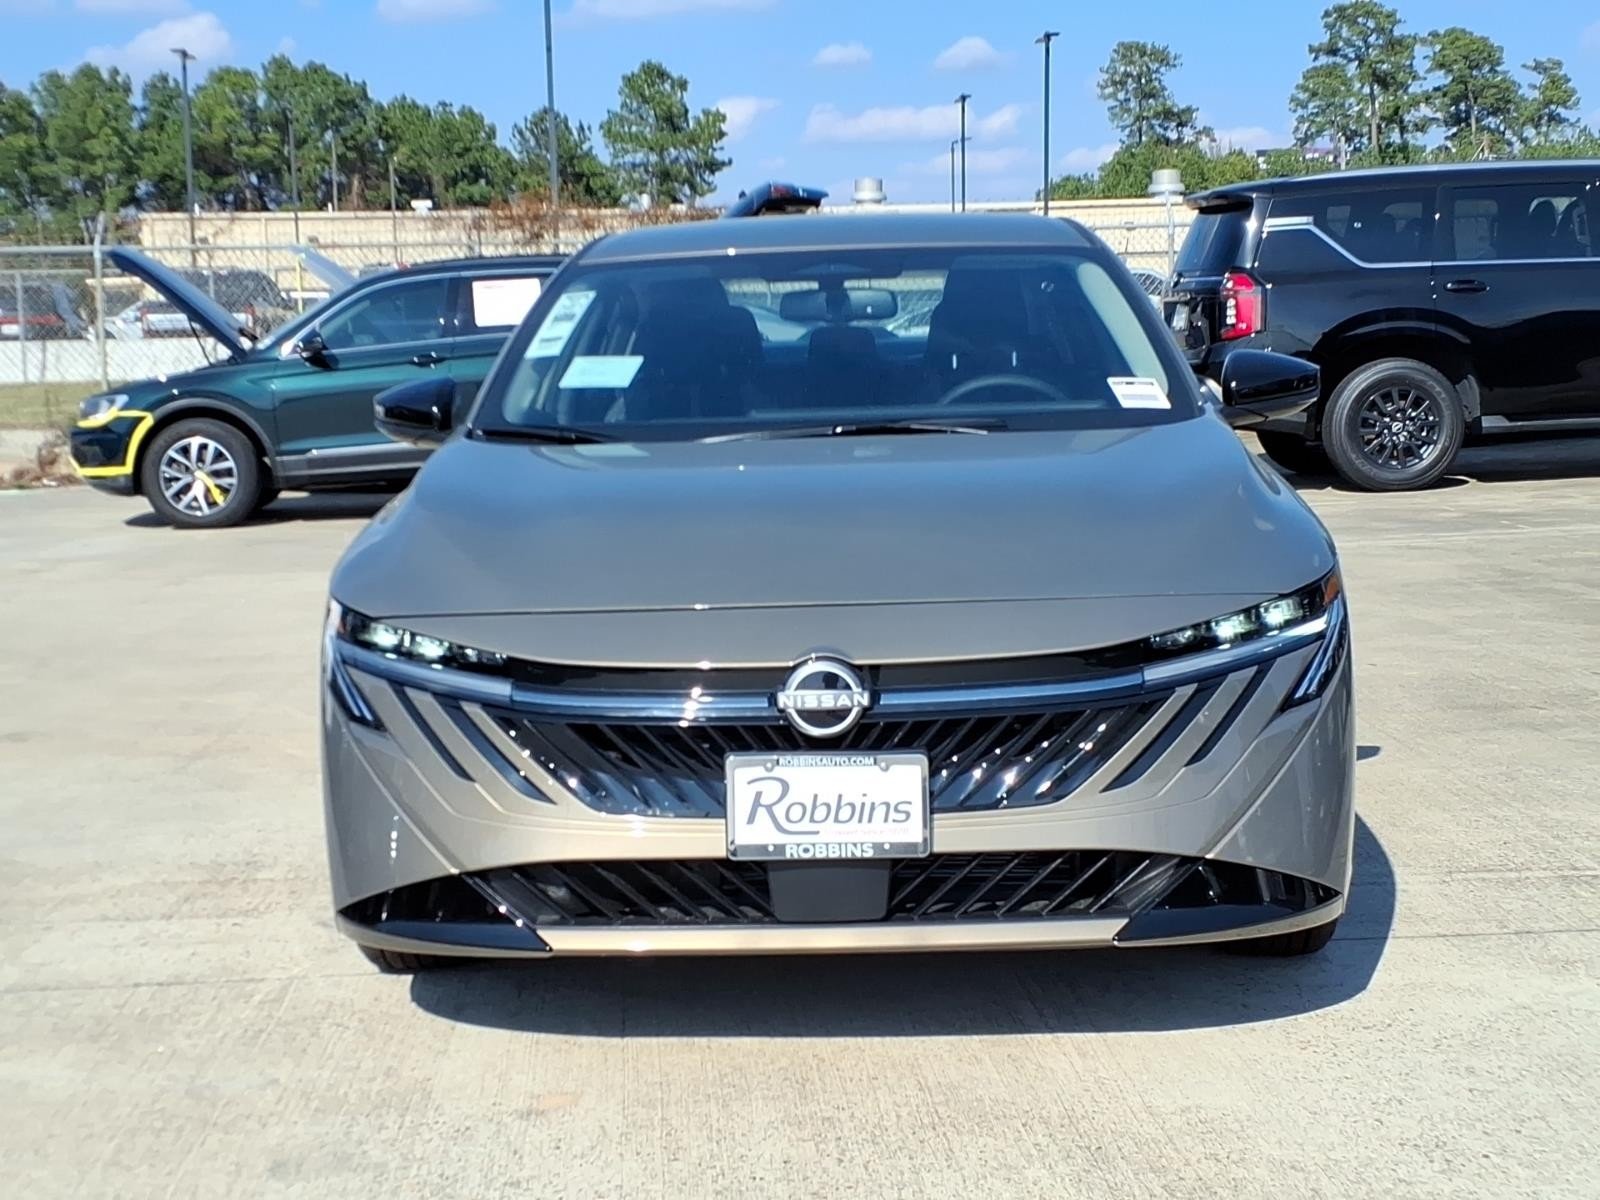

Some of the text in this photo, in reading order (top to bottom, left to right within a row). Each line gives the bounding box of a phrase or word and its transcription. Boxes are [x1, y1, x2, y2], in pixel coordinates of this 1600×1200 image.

[778, 692, 869, 710] NISSAN
[779, 757, 875, 767] ROBBINSAUTO.COM
[746, 776, 913, 835] Robbins
[785, 843, 874, 859] ROBBINS
